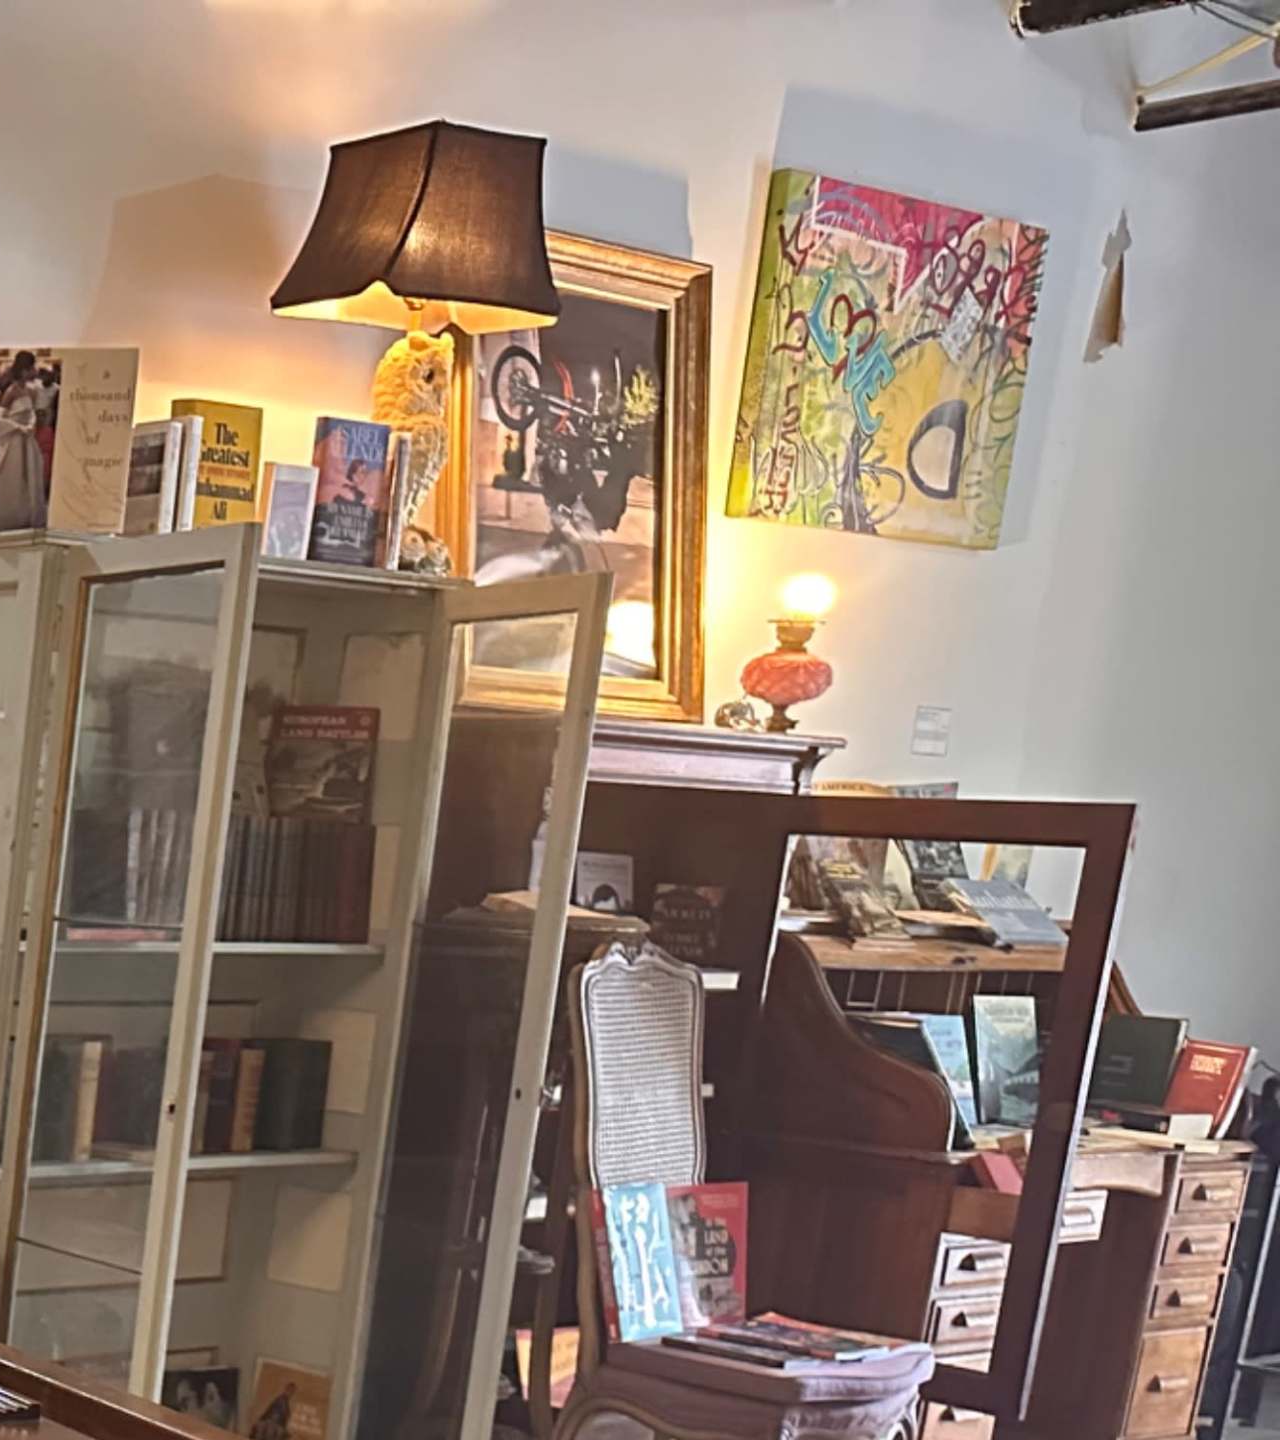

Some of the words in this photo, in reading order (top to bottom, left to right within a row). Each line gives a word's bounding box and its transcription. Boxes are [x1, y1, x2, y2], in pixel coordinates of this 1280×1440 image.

[69, 386, 132, 401] thousand
[97, 409, 129, 427] days
[214, 422, 240, 447] The
